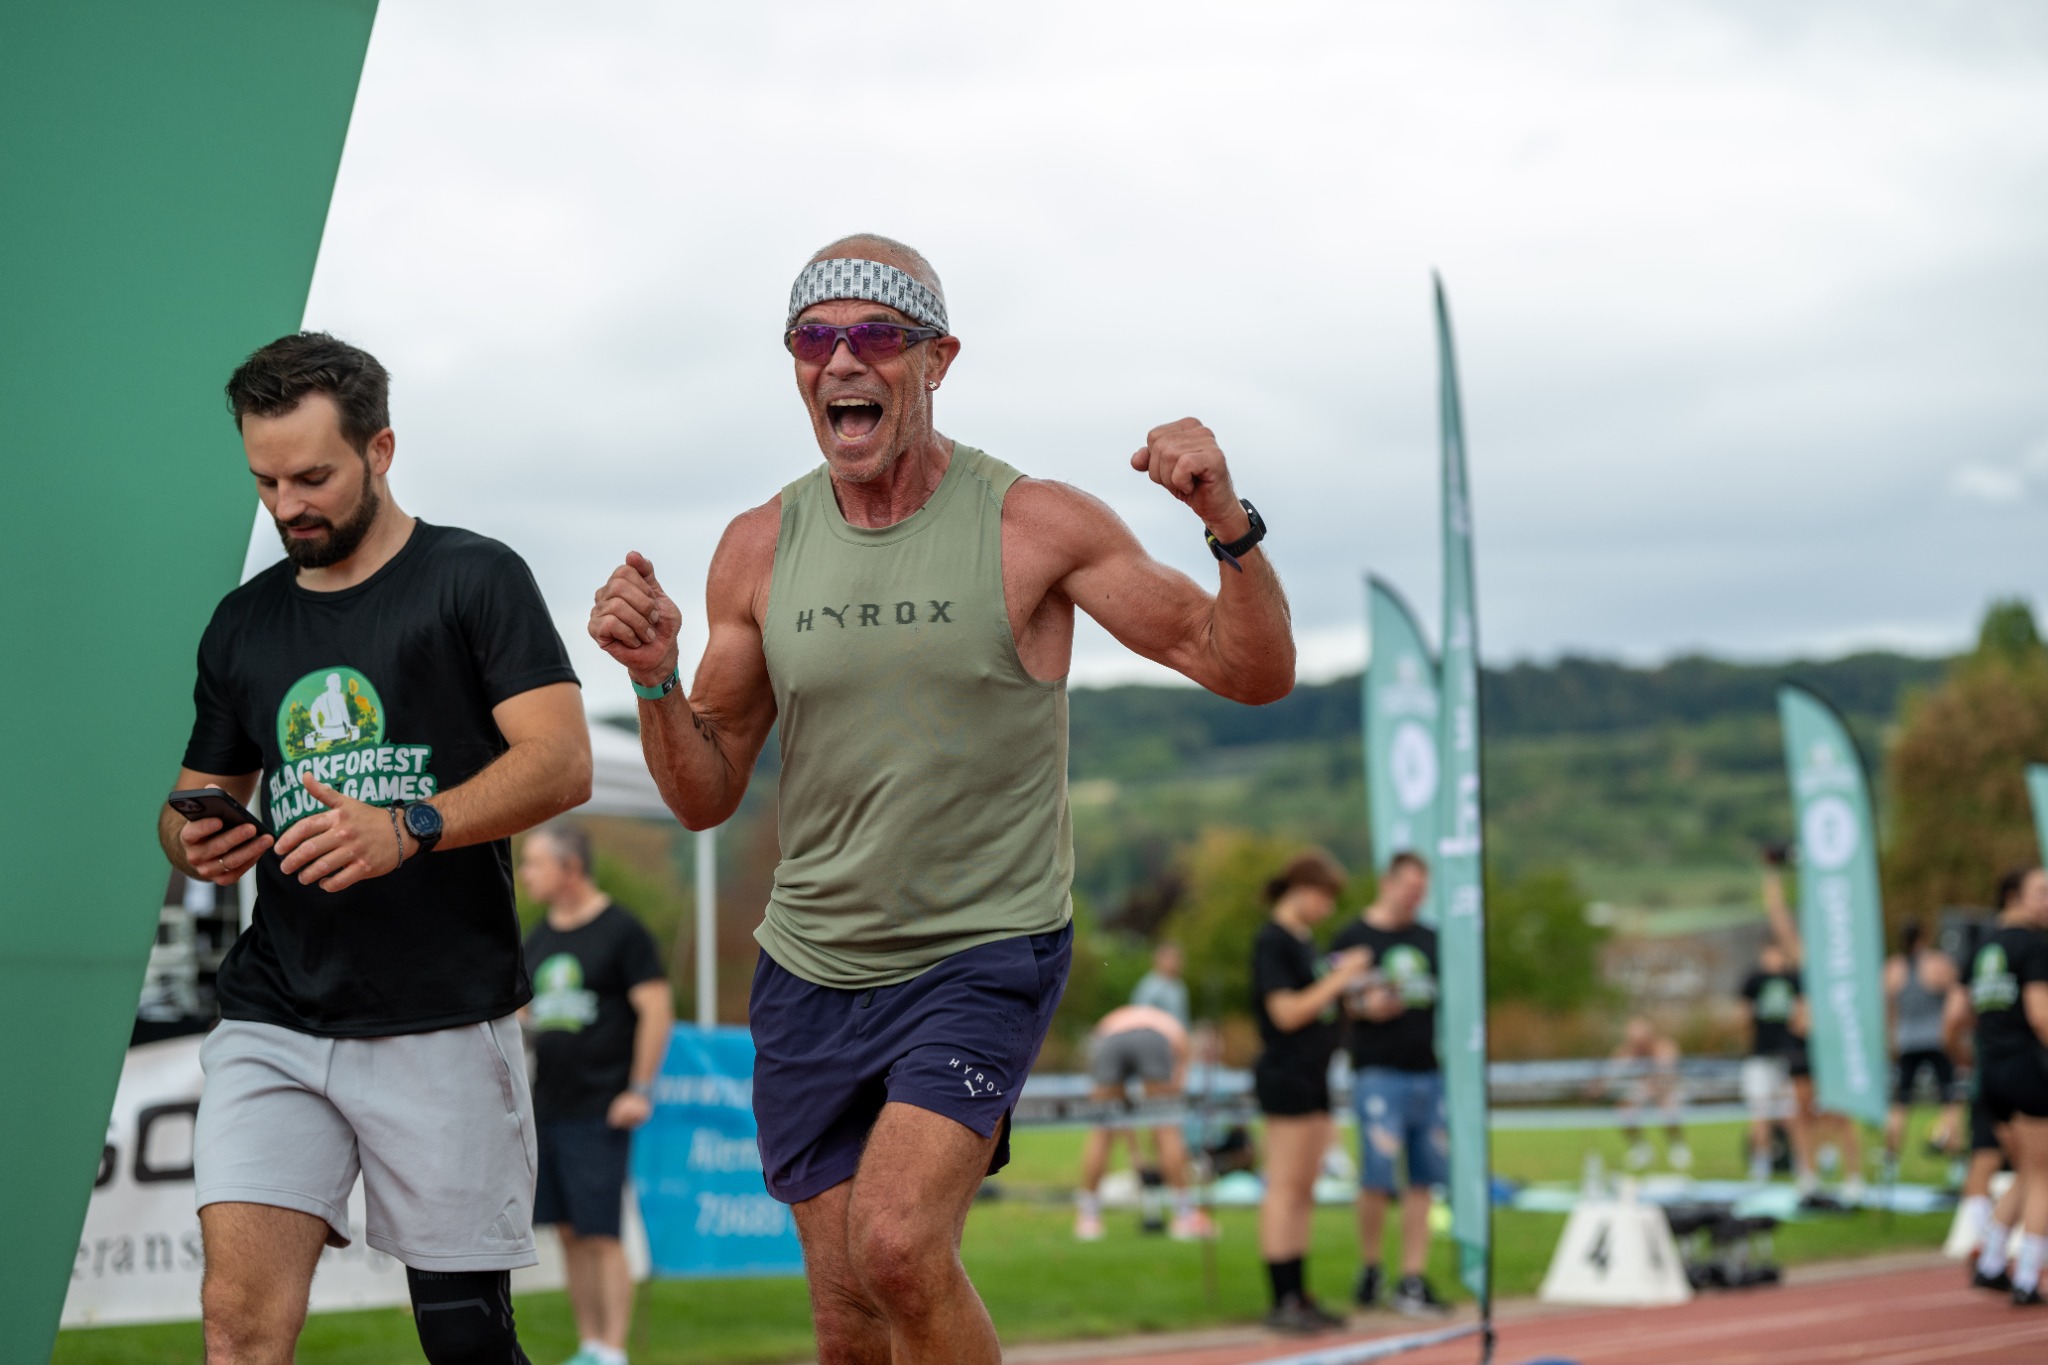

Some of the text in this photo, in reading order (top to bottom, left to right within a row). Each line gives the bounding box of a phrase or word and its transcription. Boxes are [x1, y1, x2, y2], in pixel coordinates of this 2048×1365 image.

[797, 600, 954, 633] HYROX
[269, 747, 429, 803] BLACKFOREST
[343, 775, 433, 803] GAMES
